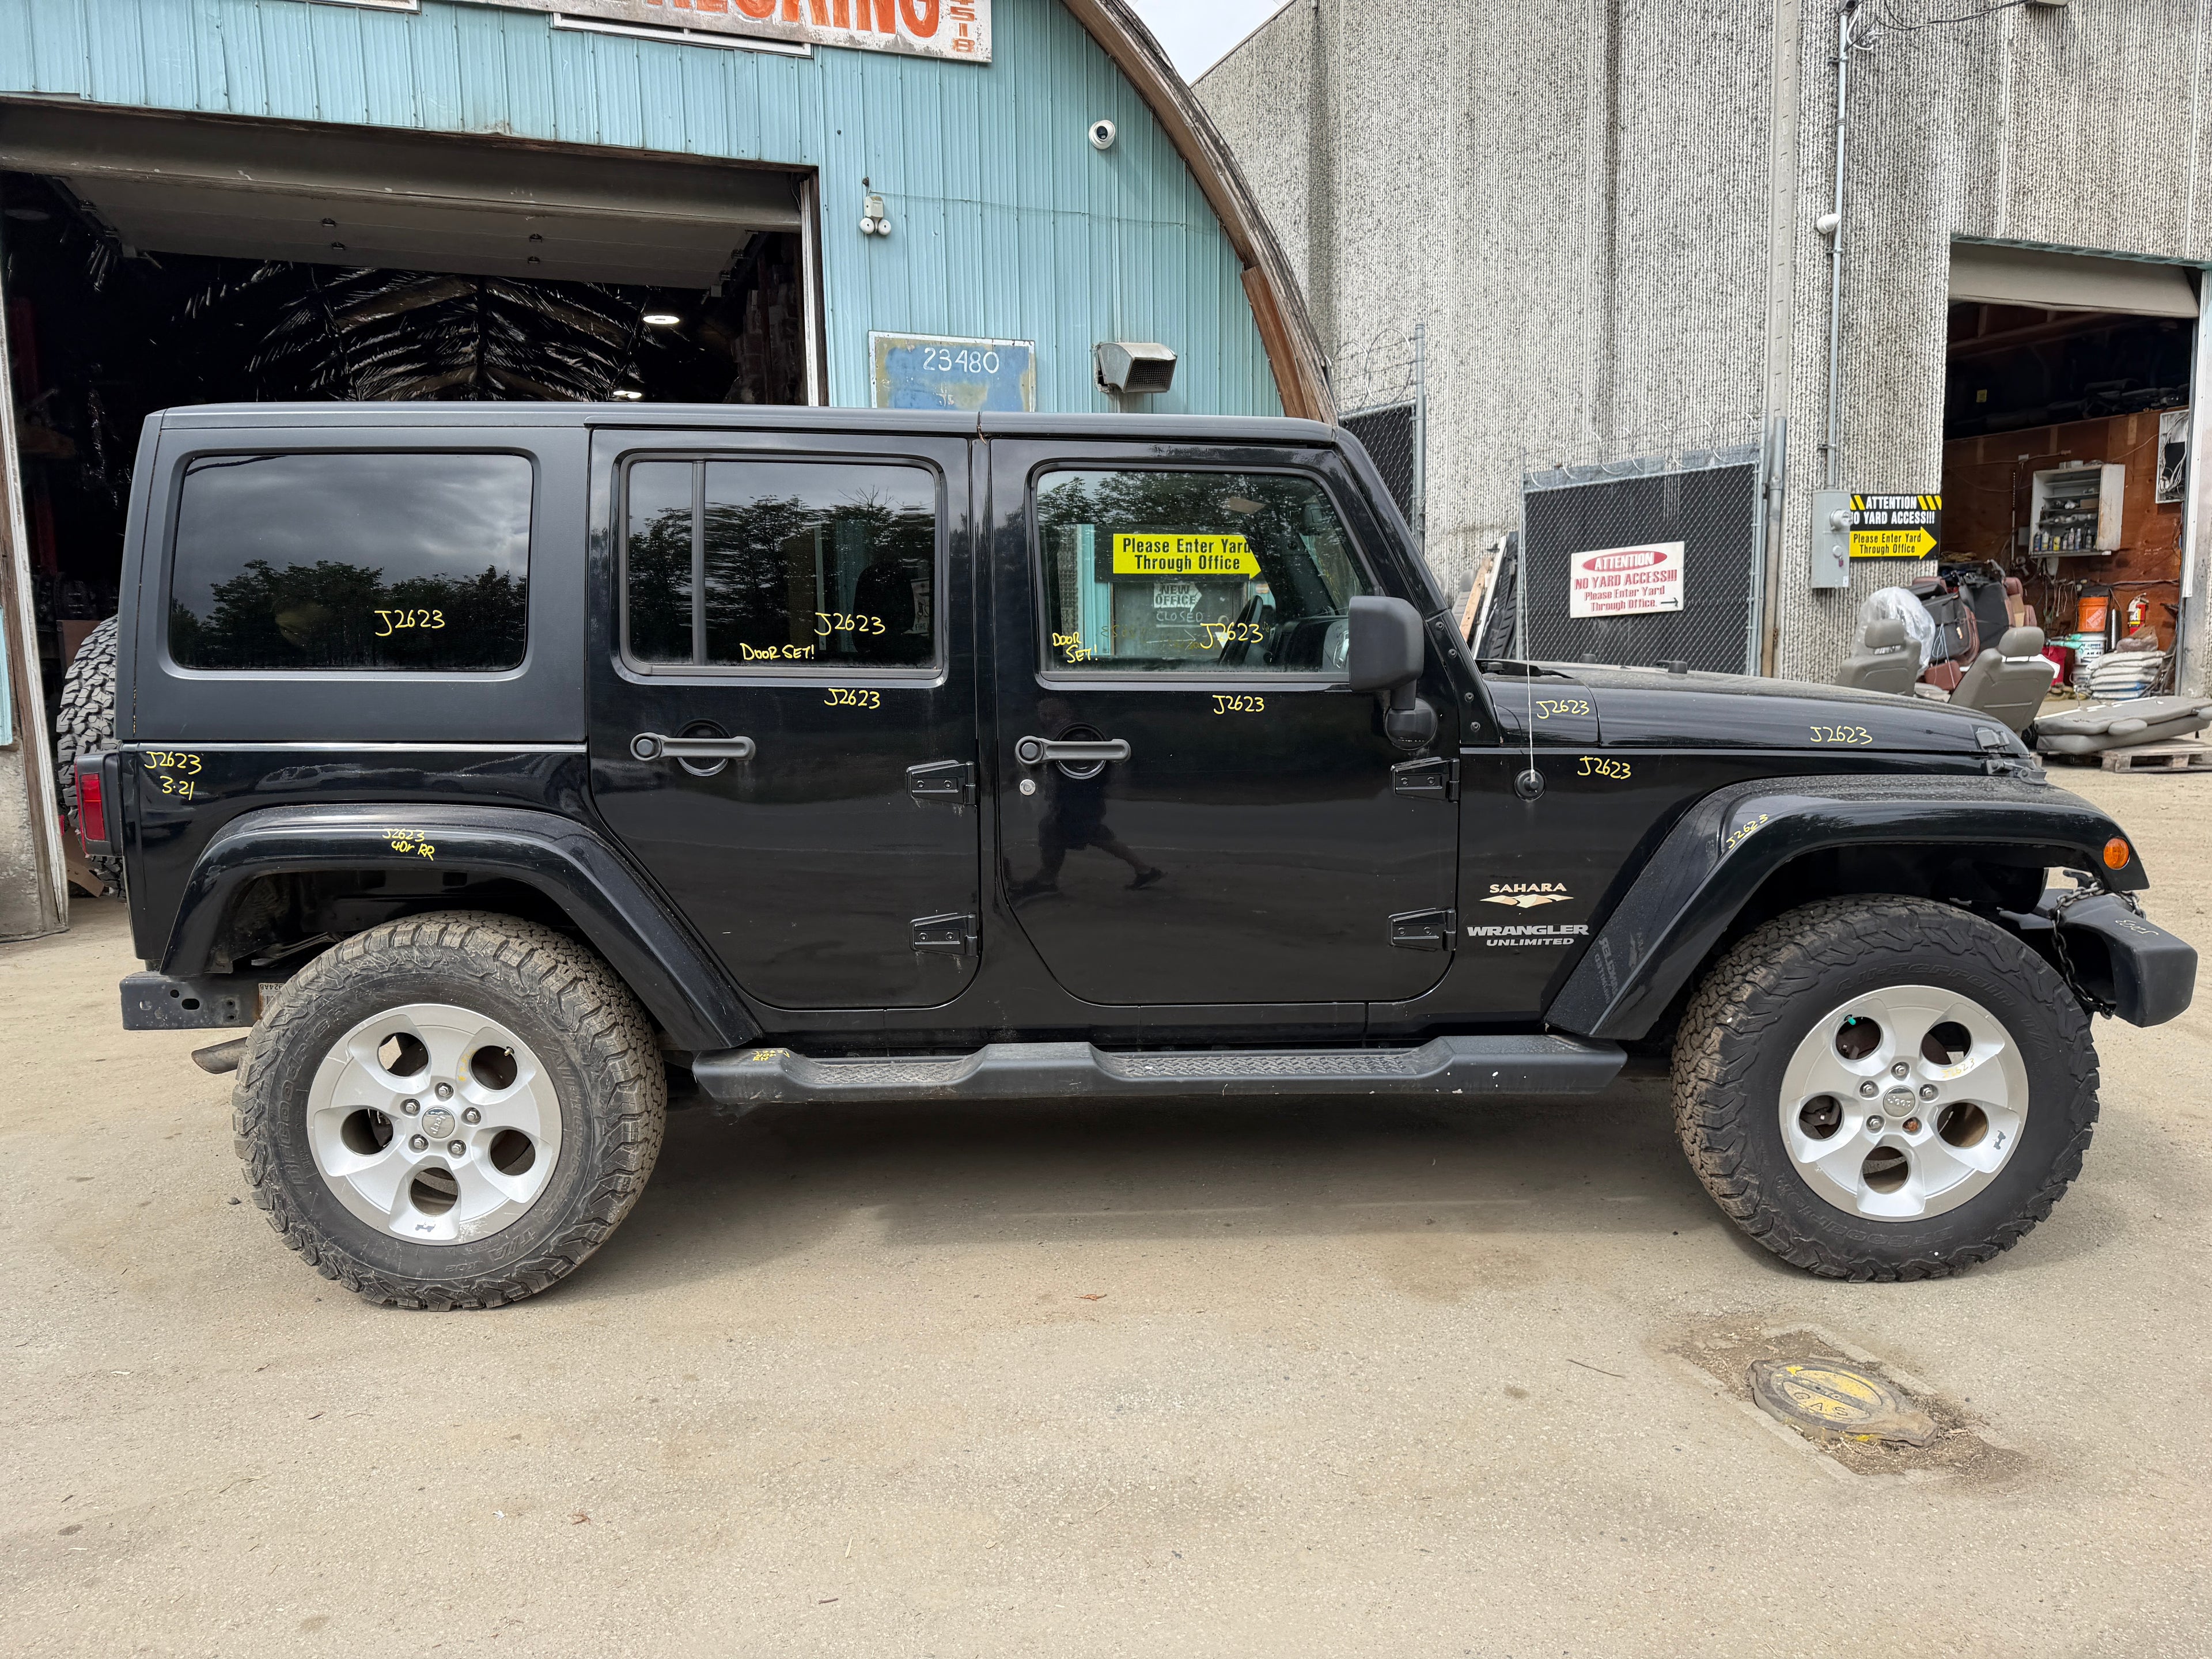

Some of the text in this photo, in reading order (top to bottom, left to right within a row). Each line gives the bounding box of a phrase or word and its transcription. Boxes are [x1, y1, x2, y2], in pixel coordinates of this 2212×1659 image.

[923, 347, 999, 374] 23480
[1865, 495, 1917, 510] ATTENTION
[1863, 511, 1888, 525] YARD
[1891, 510, 1935, 525] ACCESS!!!
[1123, 537, 1170, 554] Please
[1177, 539, 1214, 554] Enter
[1853, 533, 1921, 543] Please Enter Yard
[1859, 544, 1915, 555] Through Office
[1134, 555, 1240, 573] Through Office
[1594, 552, 1654, 571] ATTENTION
[1574, 569, 1677, 590] NO YARD ACCESS!!!
[1160, 584, 1190, 594] NEW
[1584, 585, 1665, 601] Please Enter Yard
[1155, 594, 1196, 607] OFFICE
[1590, 601, 1626, 612] Through
[374, 609, 445, 637] J2623
[814, 612, 885, 636] J2623
[1156, 611, 1203, 623] CLOSED
[1052, 632, 1080, 646] DOOR
[1200, 622, 1264, 649] J2623
[740, 643, 815, 660] DOOR SET!
[1065, 645, 1098, 663] SET!
[824, 688, 881, 709] J2623
[1212, 695, 1265, 715] J2623
[1536, 699, 1590, 719] J2623
[1809, 726, 1873, 744] J2623
[145, 751, 202, 775] J2623
[1577, 756, 1631, 778] J2623
[382, 828, 425, 842] J2623
[1726, 813, 1768, 849] J2623
[418, 843, 435, 861] RR
[1489, 882, 1567, 893] SAHARA
[1467, 925, 1589, 937] WRANGLER
[1486, 938, 1574, 946] UNLIMITED
[1793, 1392, 1849, 1416] GAS
